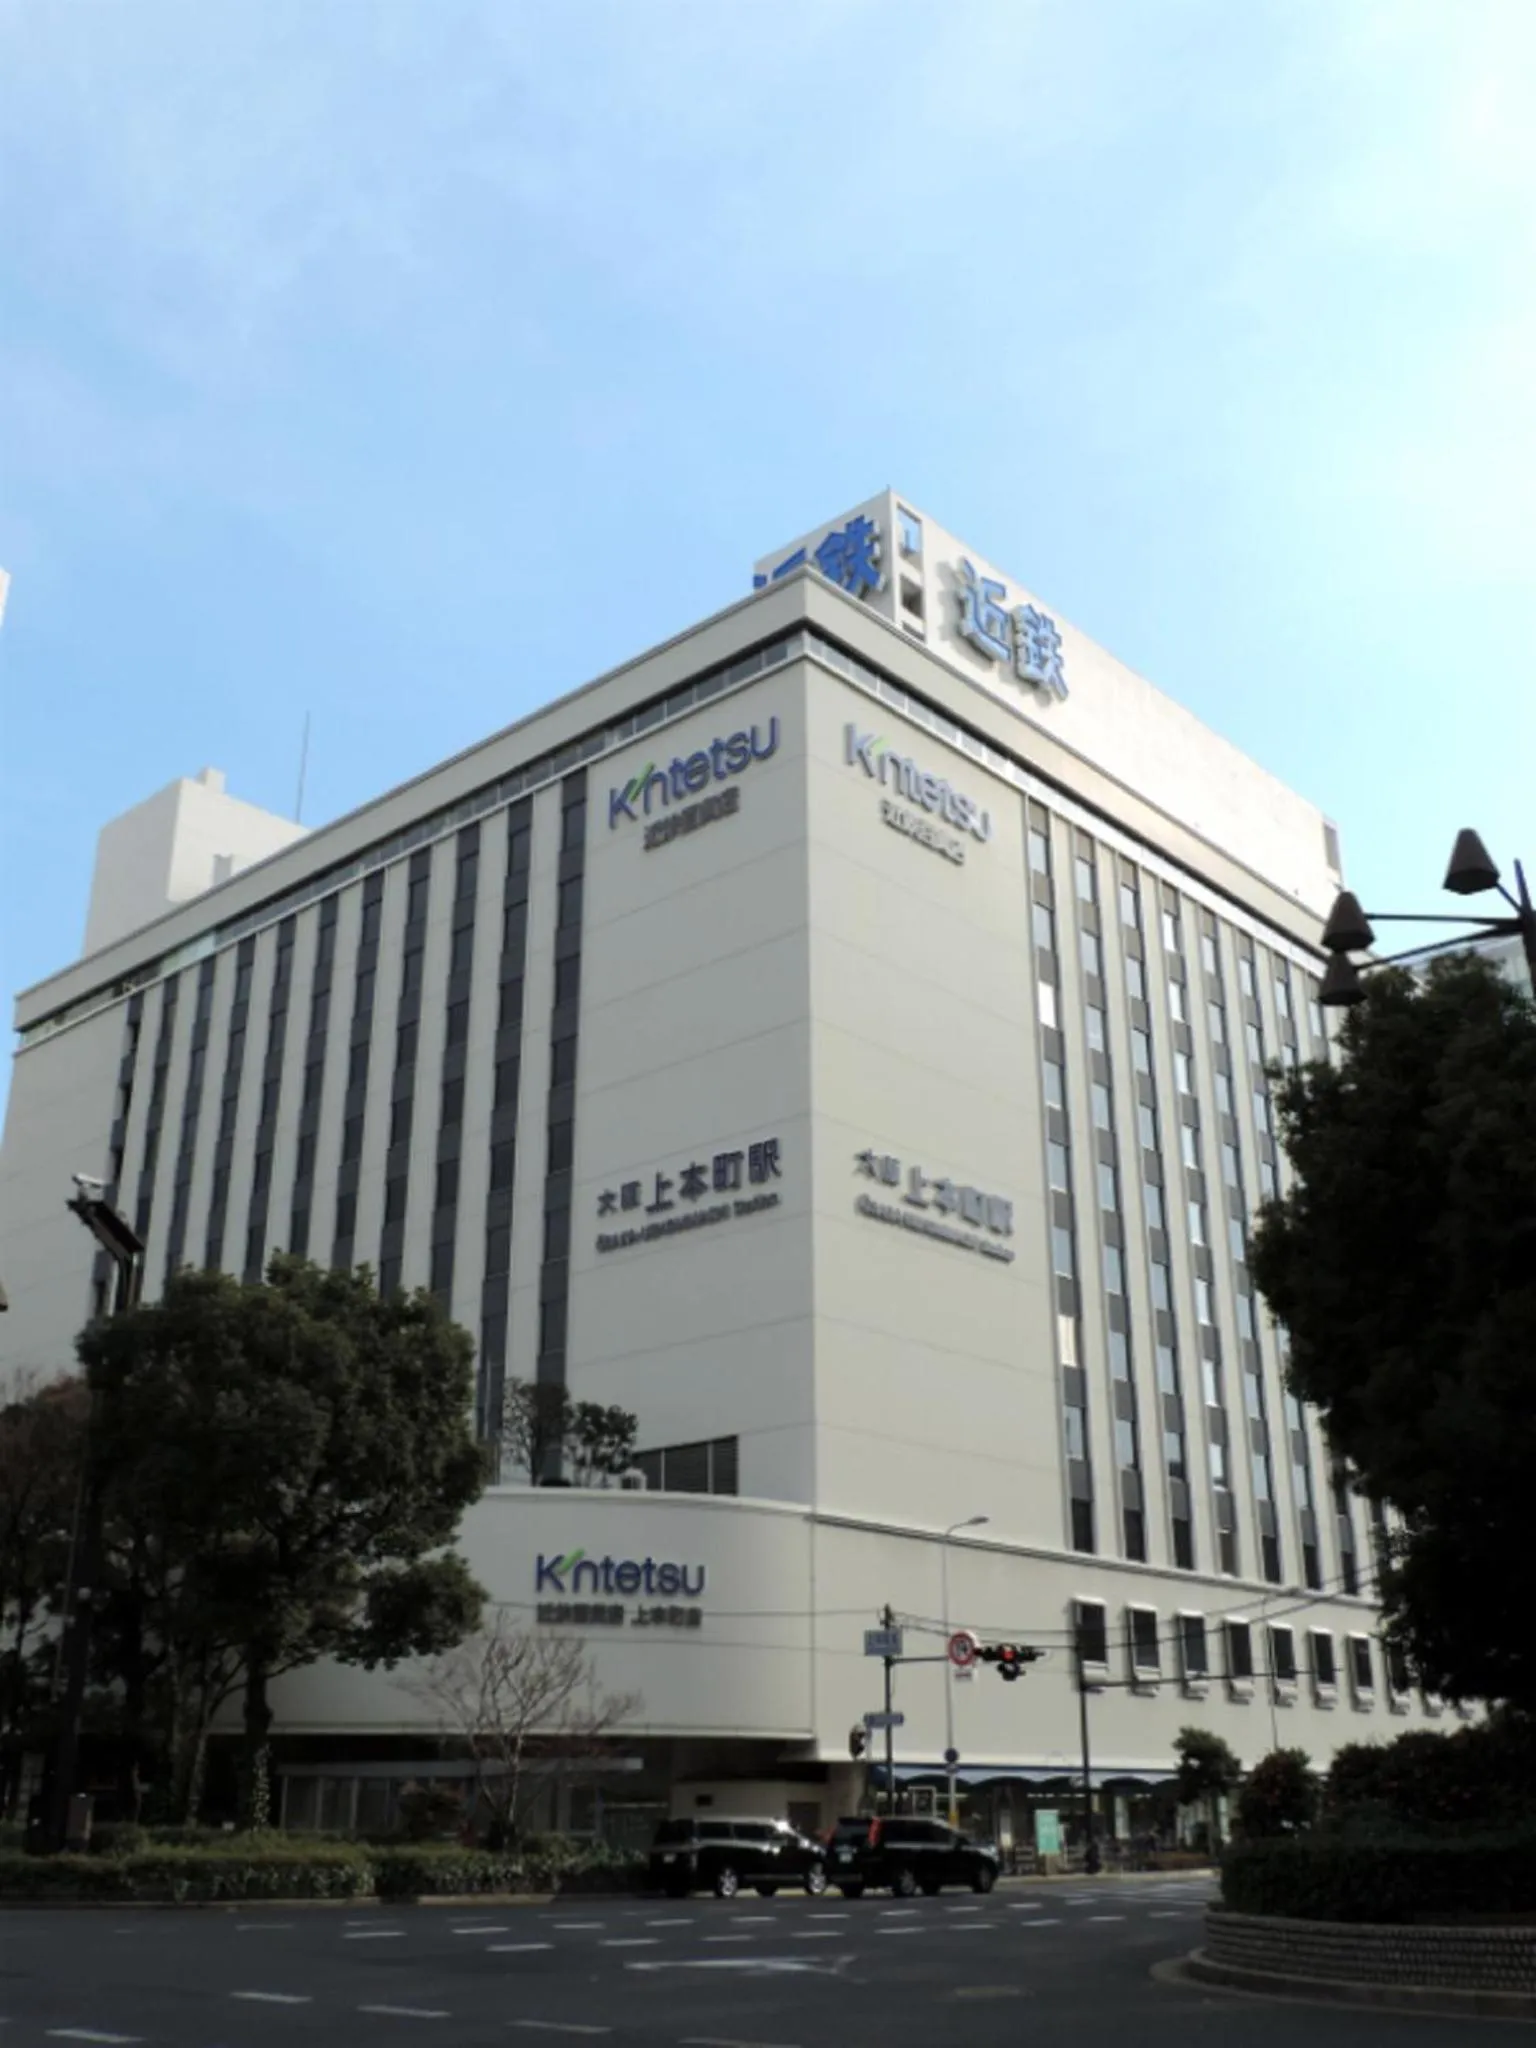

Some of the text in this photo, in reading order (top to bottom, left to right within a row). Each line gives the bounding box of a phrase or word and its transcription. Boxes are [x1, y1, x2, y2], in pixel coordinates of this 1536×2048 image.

[753, 514, 881, 597] 鉄
[957, 557, 1069, 702] 近鉄
[608, 716, 781, 829] Kintetsu
[536, 1548, 705, 1597] Kintetsu
